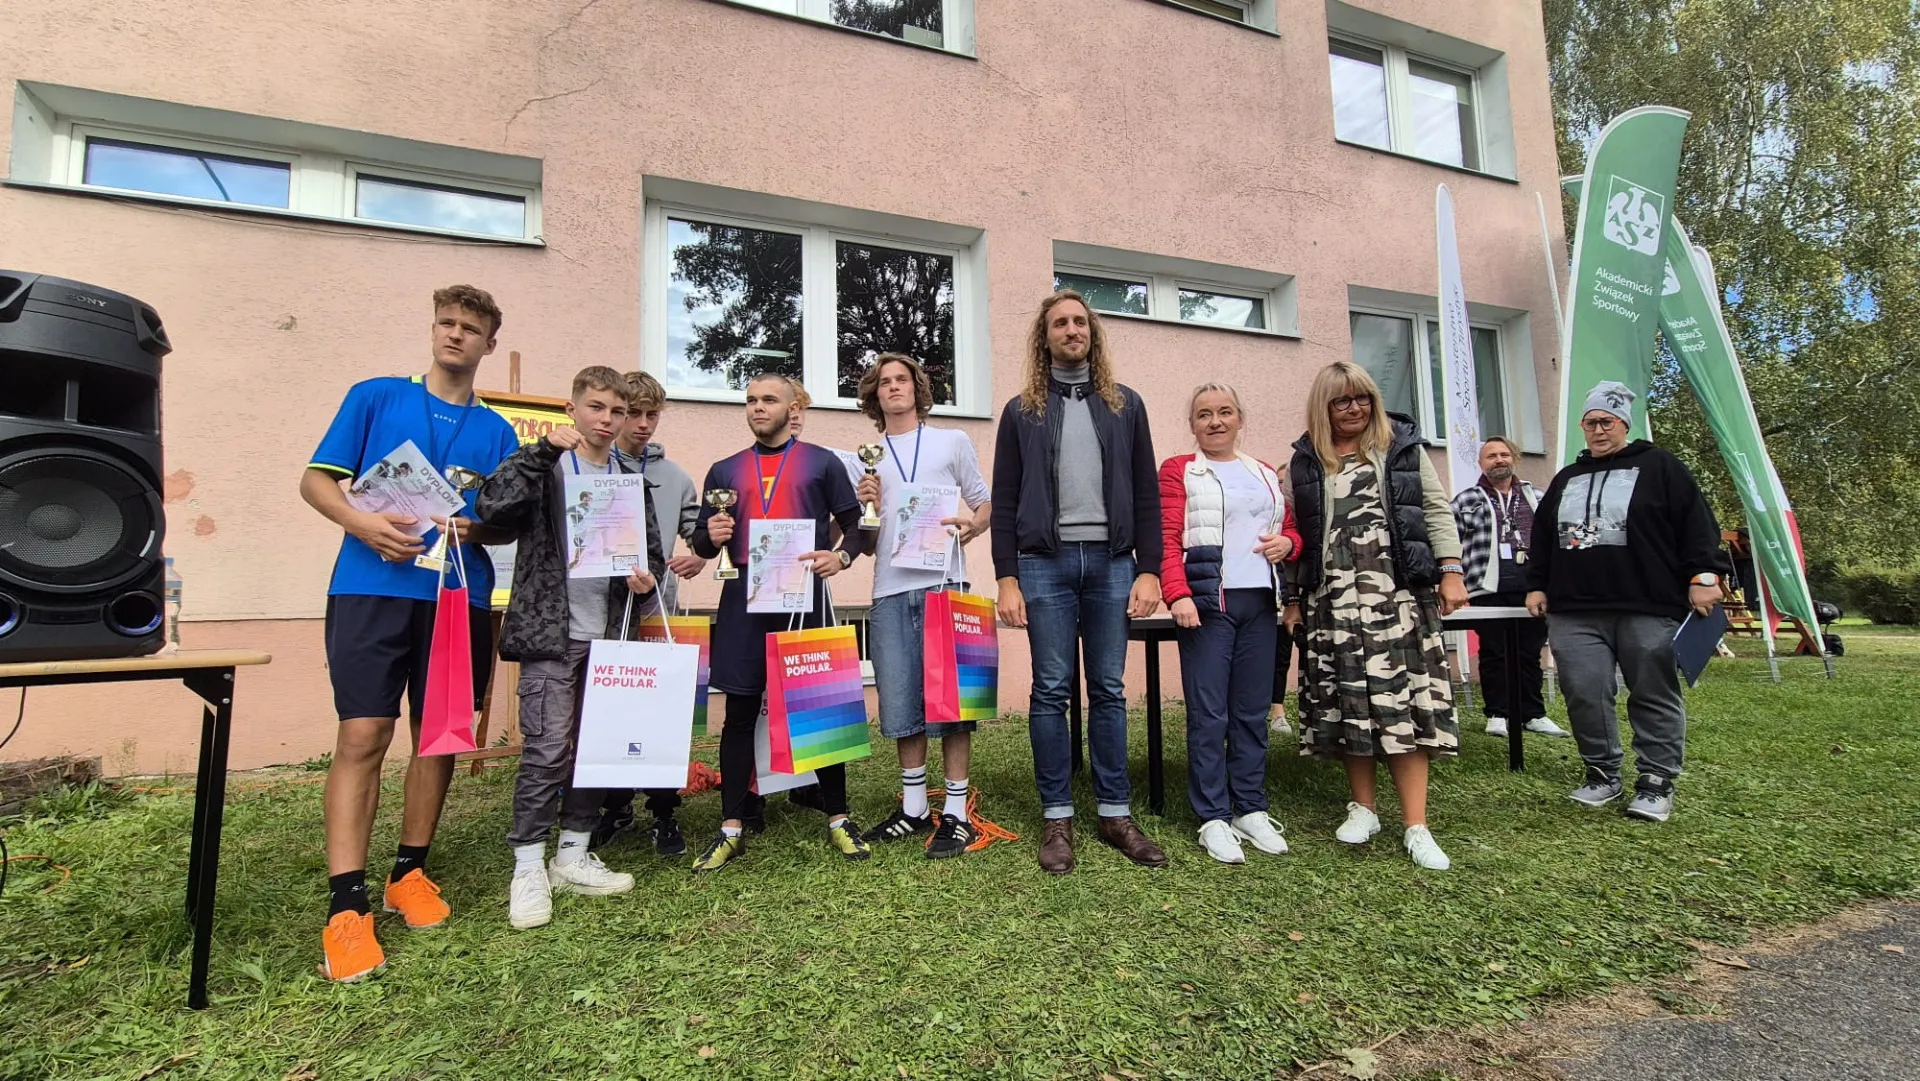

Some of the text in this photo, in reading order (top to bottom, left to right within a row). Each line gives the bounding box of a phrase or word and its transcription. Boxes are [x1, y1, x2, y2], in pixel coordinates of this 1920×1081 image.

[1595, 267, 1653, 296] Akademicki
[1594, 281, 1634, 304] Związek
[1592, 295, 1640, 323] Sportowy
[420, 467, 459, 509] DYPLOM
[594, 479, 640, 488] DYPLOM
[922, 487, 958, 496] DYPLOM
[773, 523, 812, 532] DYPLOM
[953, 612, 981, 624] WE THINK
[954, 622, 983, 635] POPULAR.
[783, 651, 831, 665] WE THINK
[594, 665, 657, 677] WE THINK
[786, 661, 833, 677] POPULAR.
[593, 677, 657, 688] POPULAR.
